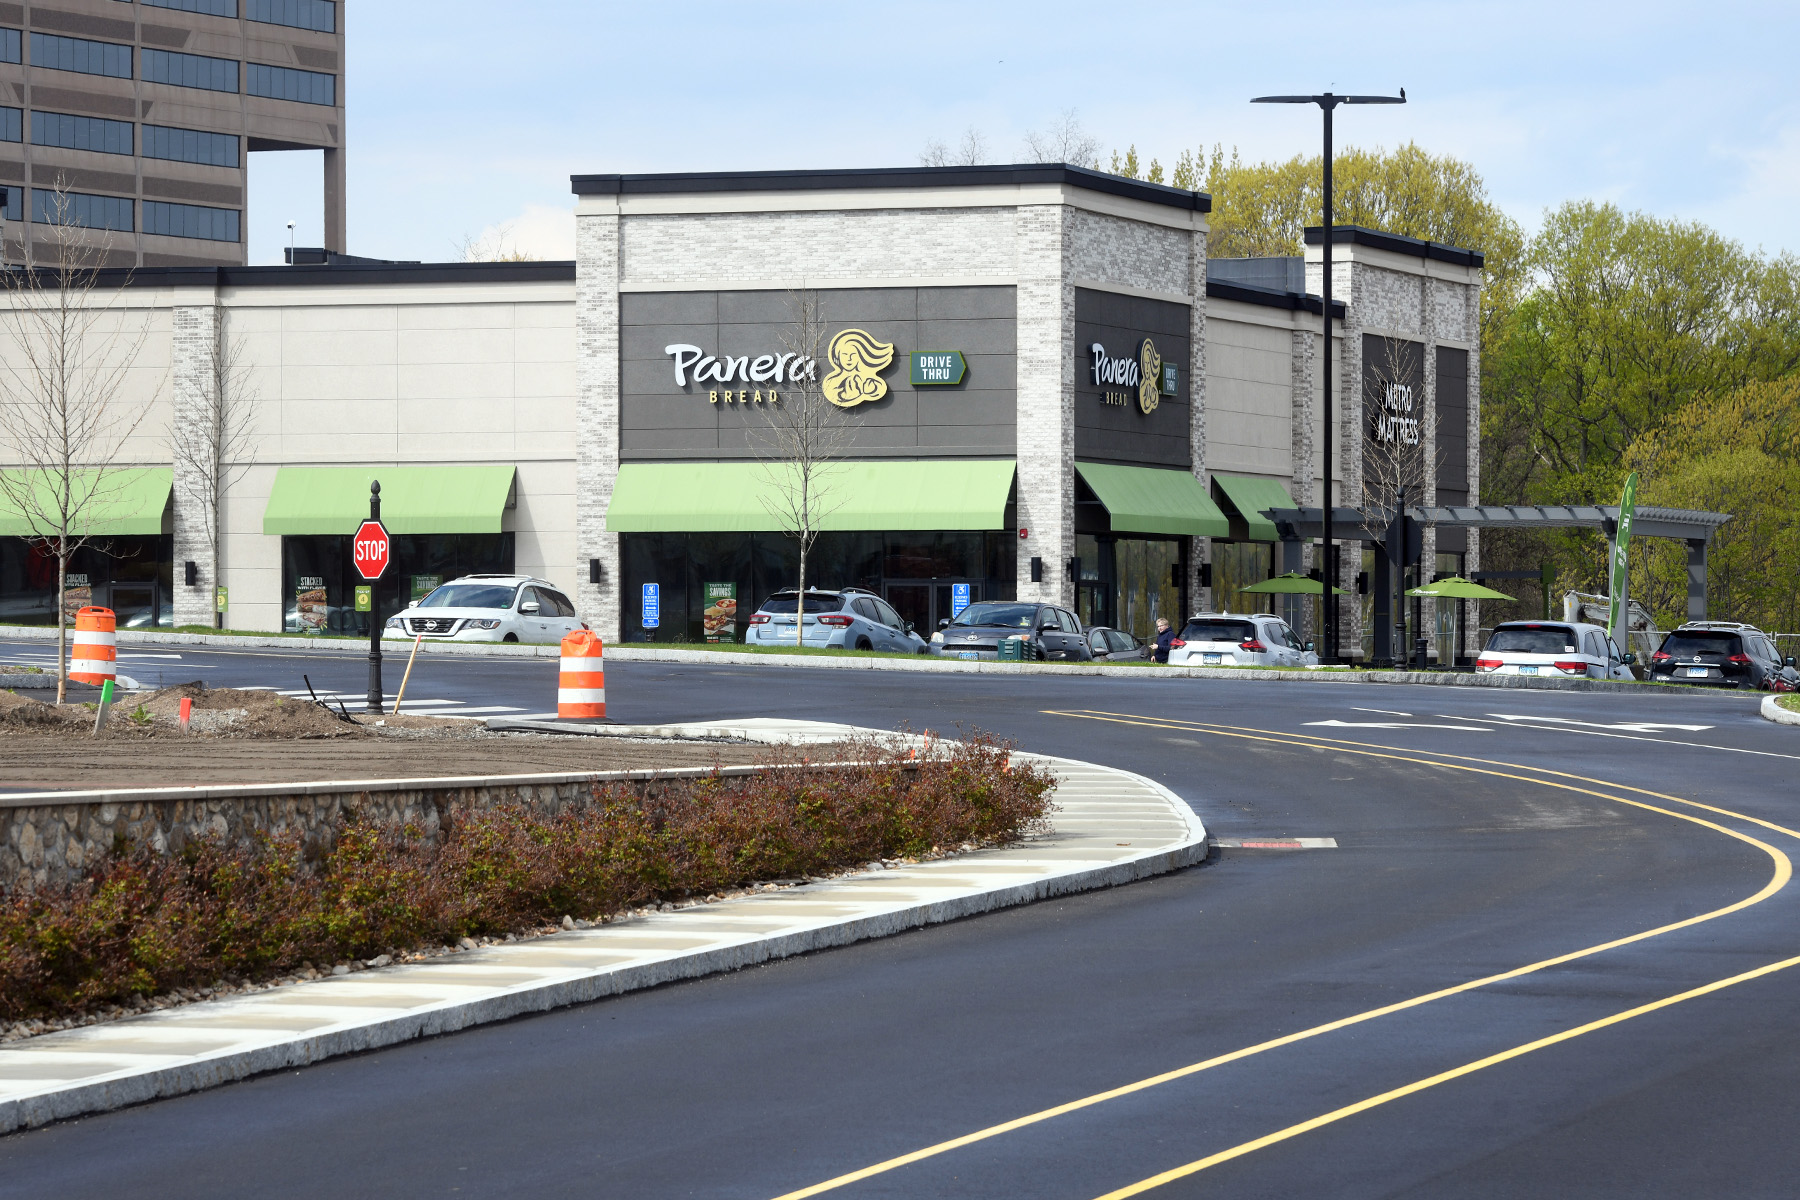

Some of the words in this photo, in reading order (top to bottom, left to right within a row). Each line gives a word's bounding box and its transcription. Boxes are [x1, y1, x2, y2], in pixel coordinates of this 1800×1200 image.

[665, 343, 817, 387] Panera
[920, 356, 952, 368] DRIVE
[1092, 343, 1138, 387] Panera
[922, 368, 950, 380] THRU
[709, 390, 778, 403] BREAD
[1106, 391, 1127, 407] BREAD
[1385, 381, 1412, 412] METRO
[356, 540, 386, 561] STOP
